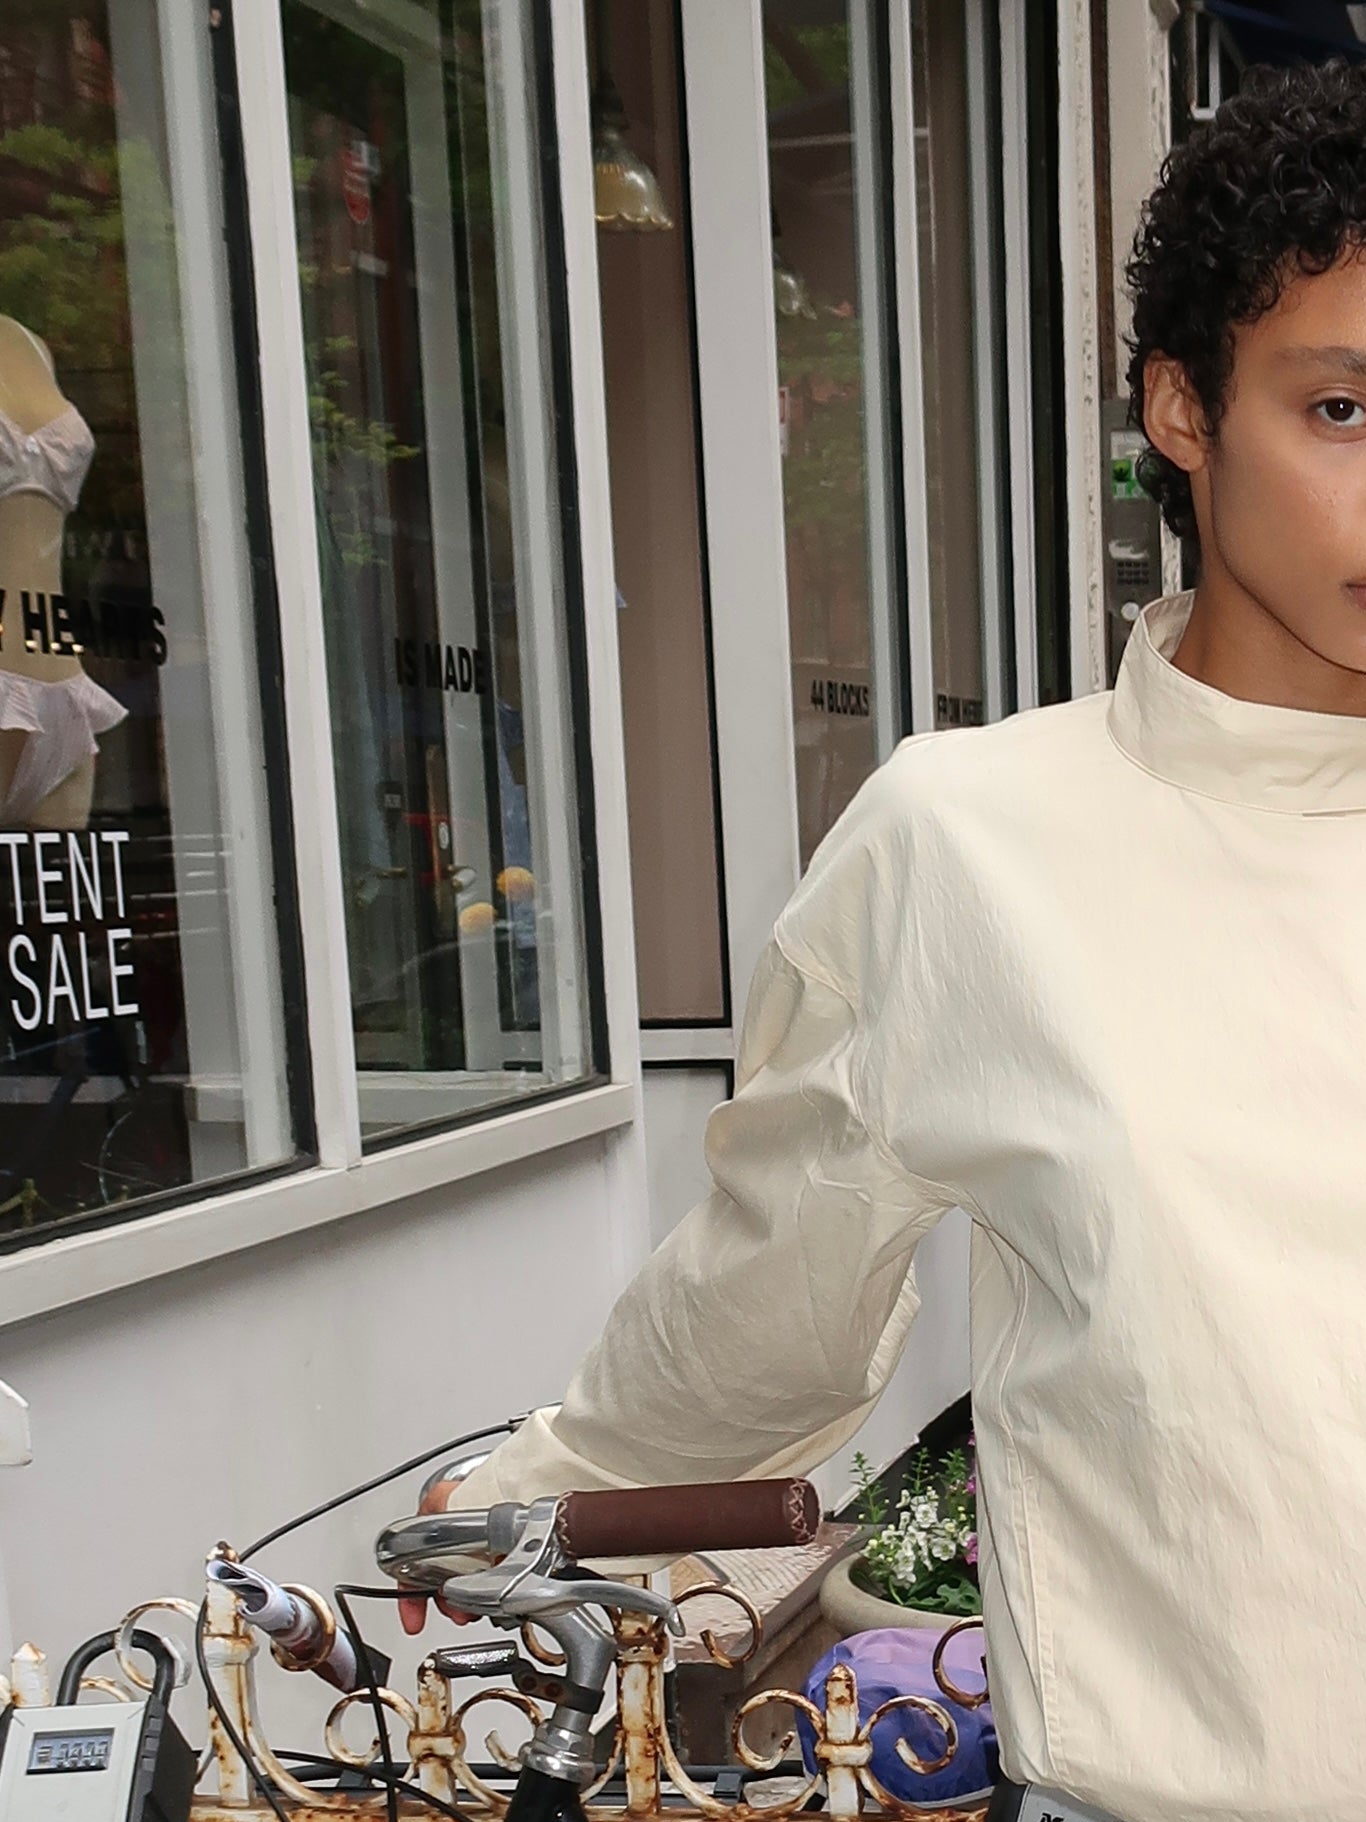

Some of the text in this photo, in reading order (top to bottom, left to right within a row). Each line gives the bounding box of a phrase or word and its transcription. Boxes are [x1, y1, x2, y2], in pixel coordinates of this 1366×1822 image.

[810, 679, 870, 717] 44 BLOCKS
[0, 831, 130, 926] TENT
[8, 928, 140, 1030] SALE
